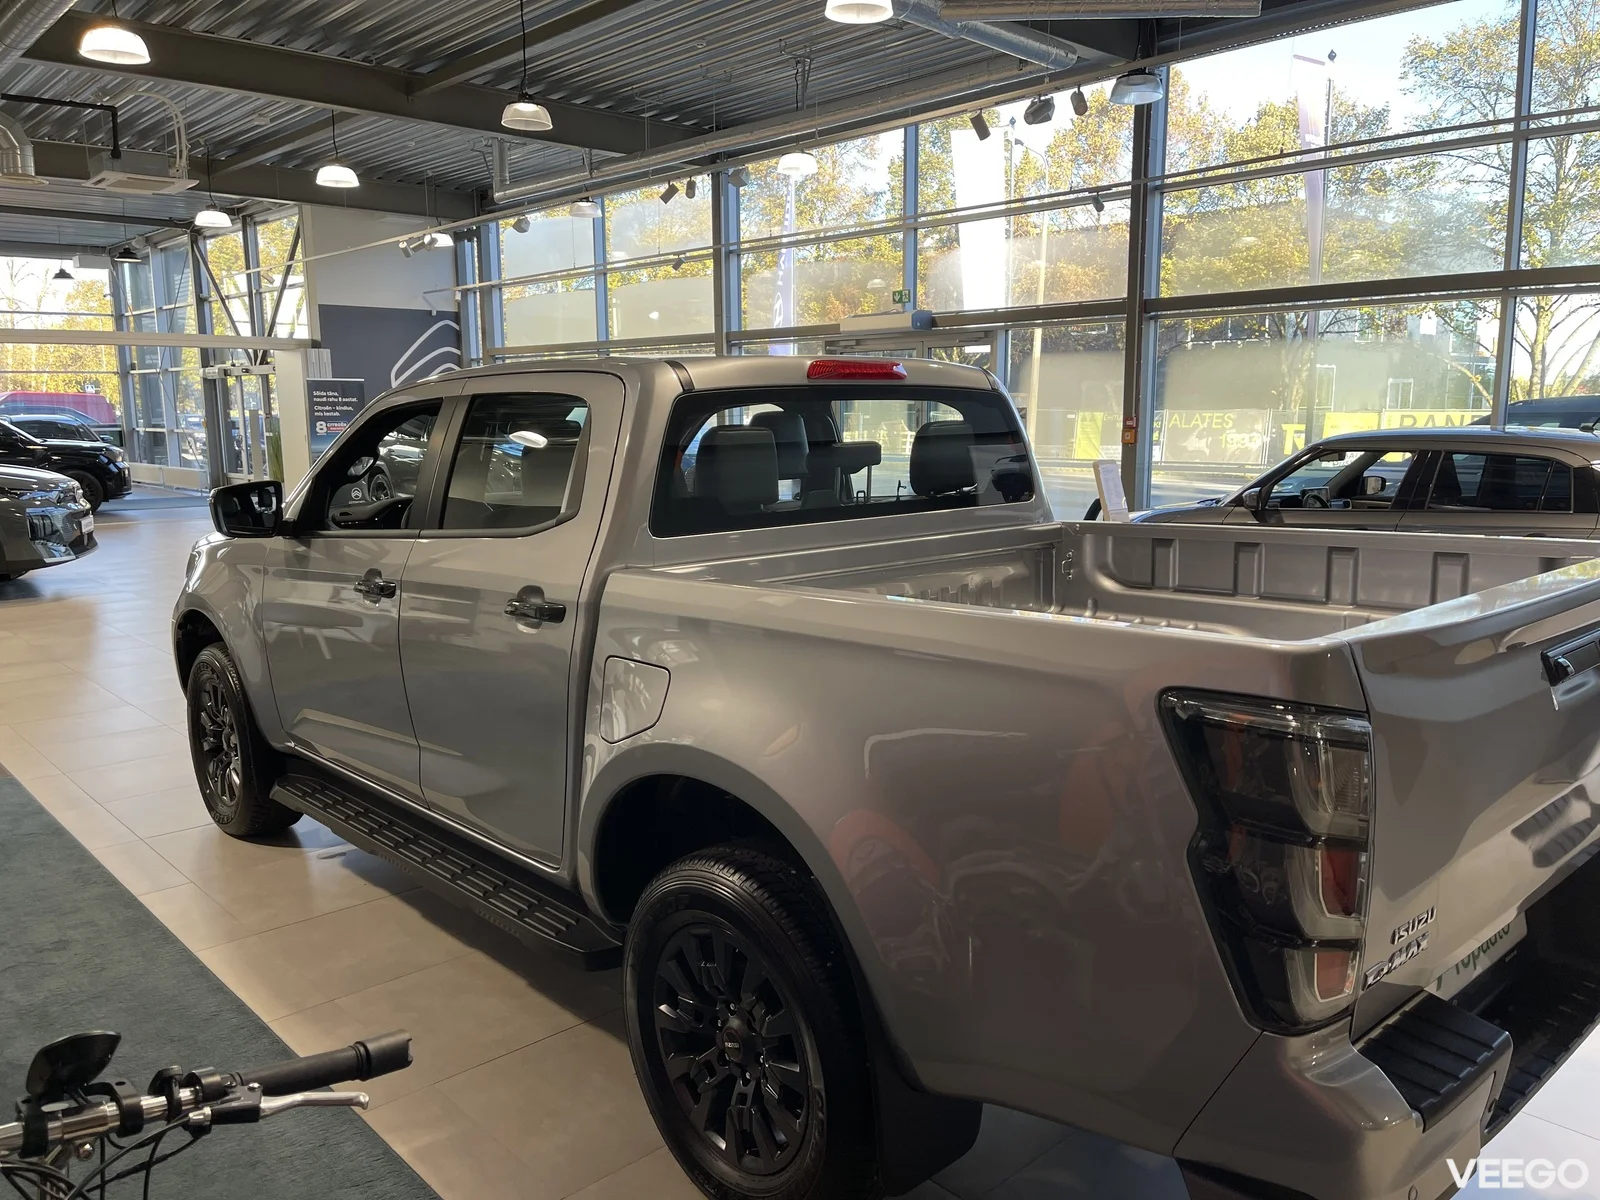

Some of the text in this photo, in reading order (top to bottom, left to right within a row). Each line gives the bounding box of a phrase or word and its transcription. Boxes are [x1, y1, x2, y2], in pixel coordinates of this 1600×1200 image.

[316, 421, 327, 433] 8
[1169, 413, 1233, 428] ALATES
[1390, 906, 1437, 945] ISUZU
[1362, 931, 1430, 991] D-MAX
